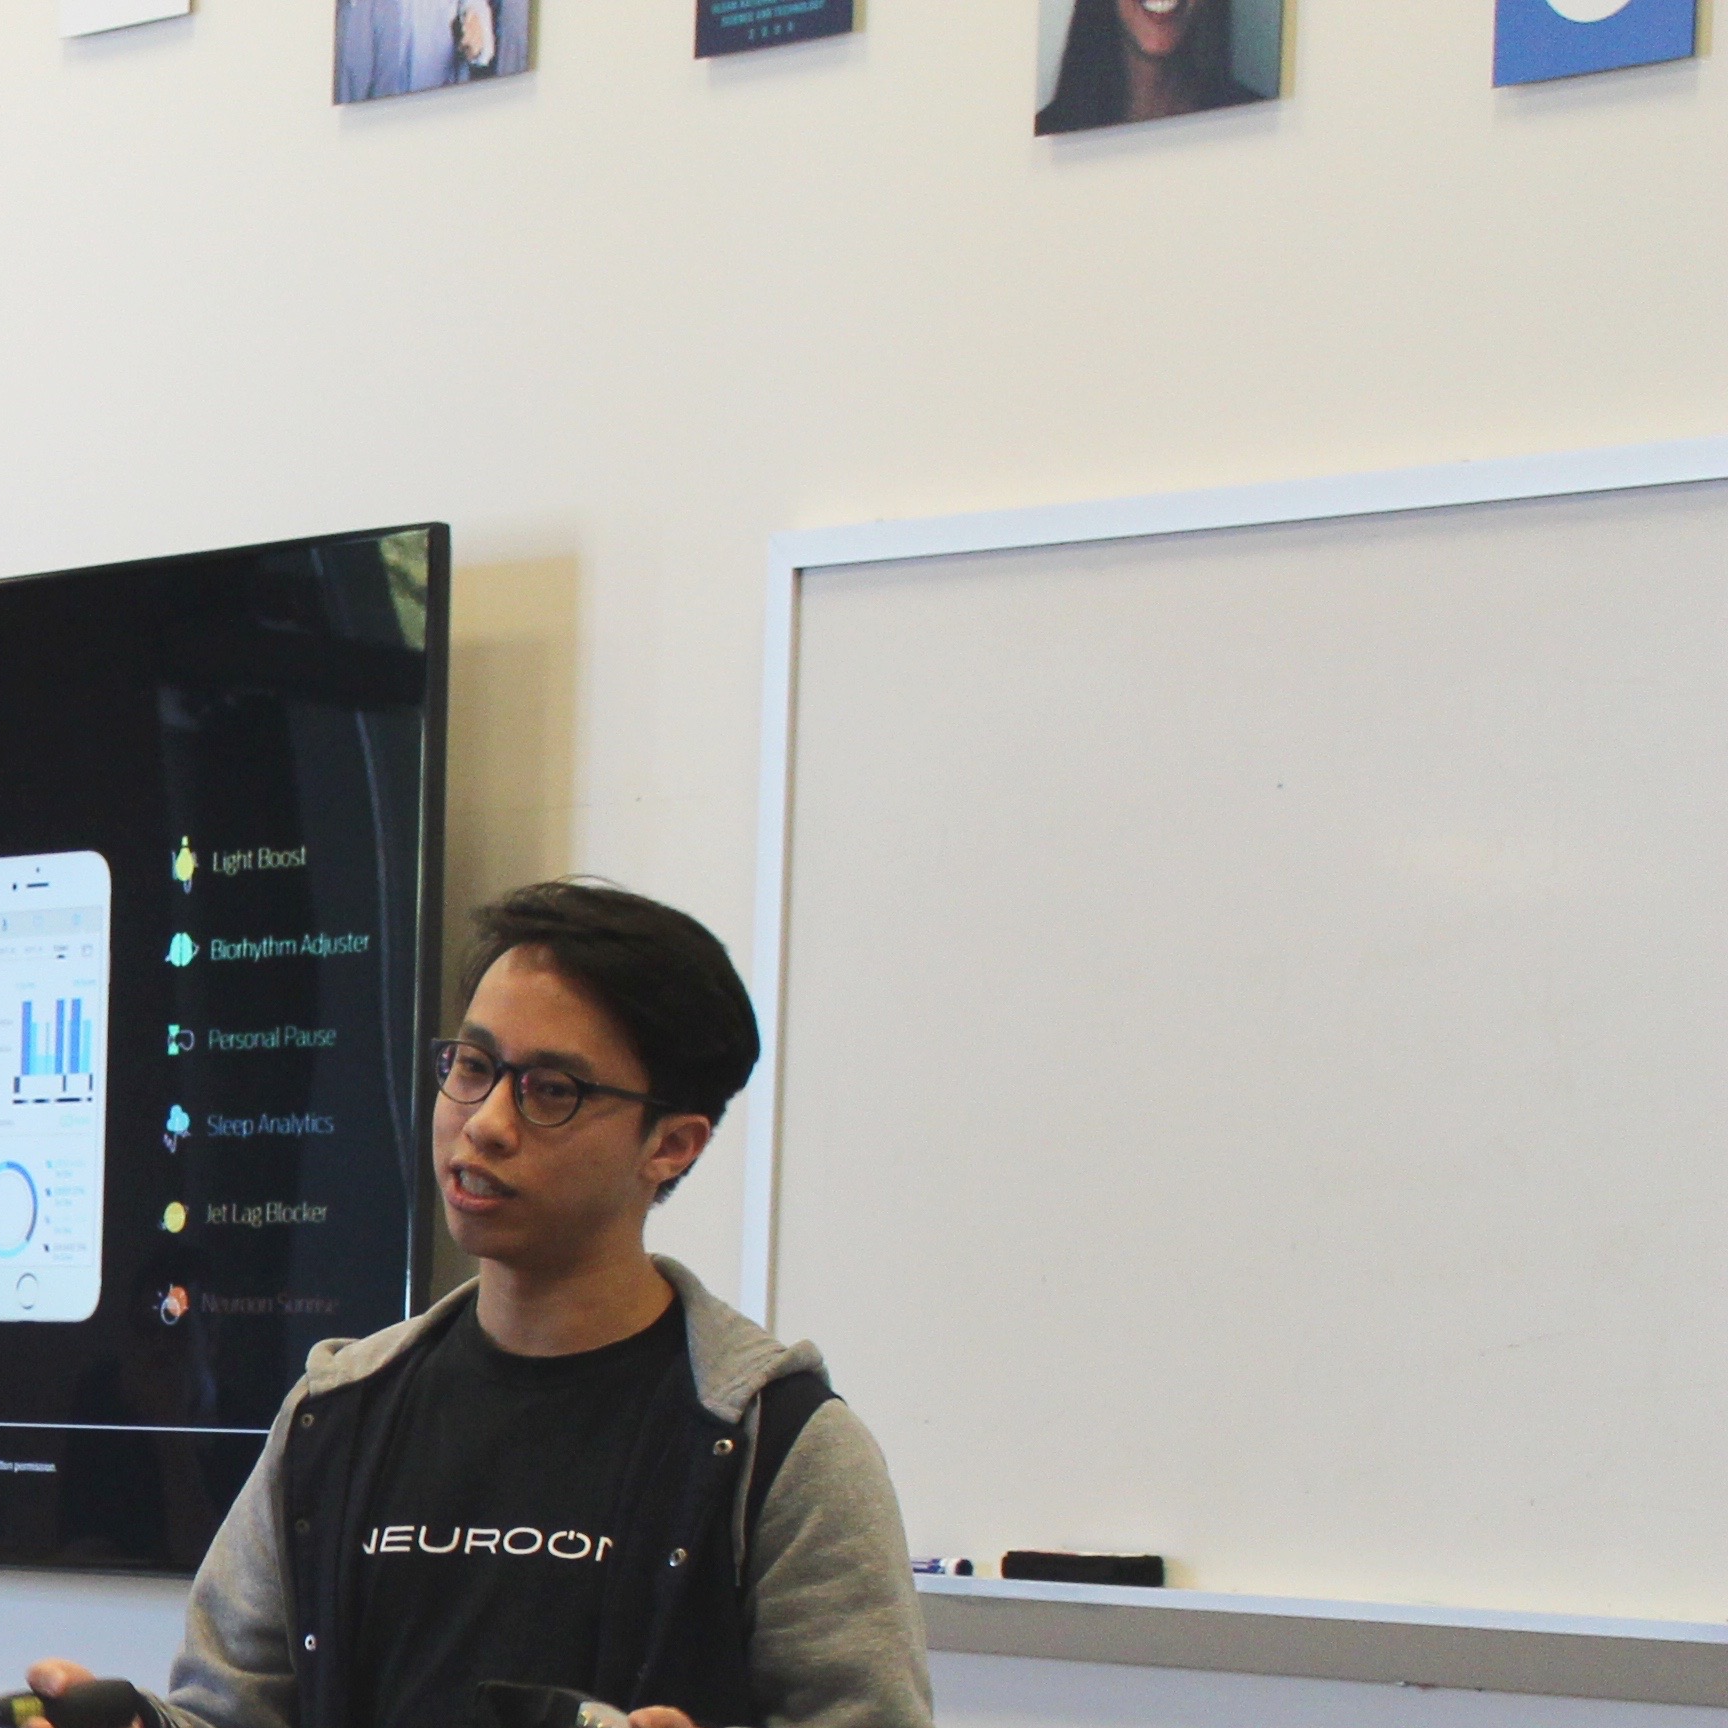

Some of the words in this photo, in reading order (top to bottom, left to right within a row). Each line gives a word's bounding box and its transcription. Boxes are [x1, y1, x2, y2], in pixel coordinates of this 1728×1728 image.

[212, 850, 253, 876] Light
[257, 846, 307, 869] Boost
[210, 936, 297, 962] Biorhythm
[300, 931, 371, 958] Adjuster
[208, 1027, 280, 1051] Personal
[284, 1025, 338, 1049] Pause
[206, 1114, 254, 1138] Sleep
[257, 1112, 335, 1137] Analytics
[205, 1203, 229, 1225] Jet
[231, 1203, 263, 1228] Lag
[265, 1201, 329, 1224] Blocker
